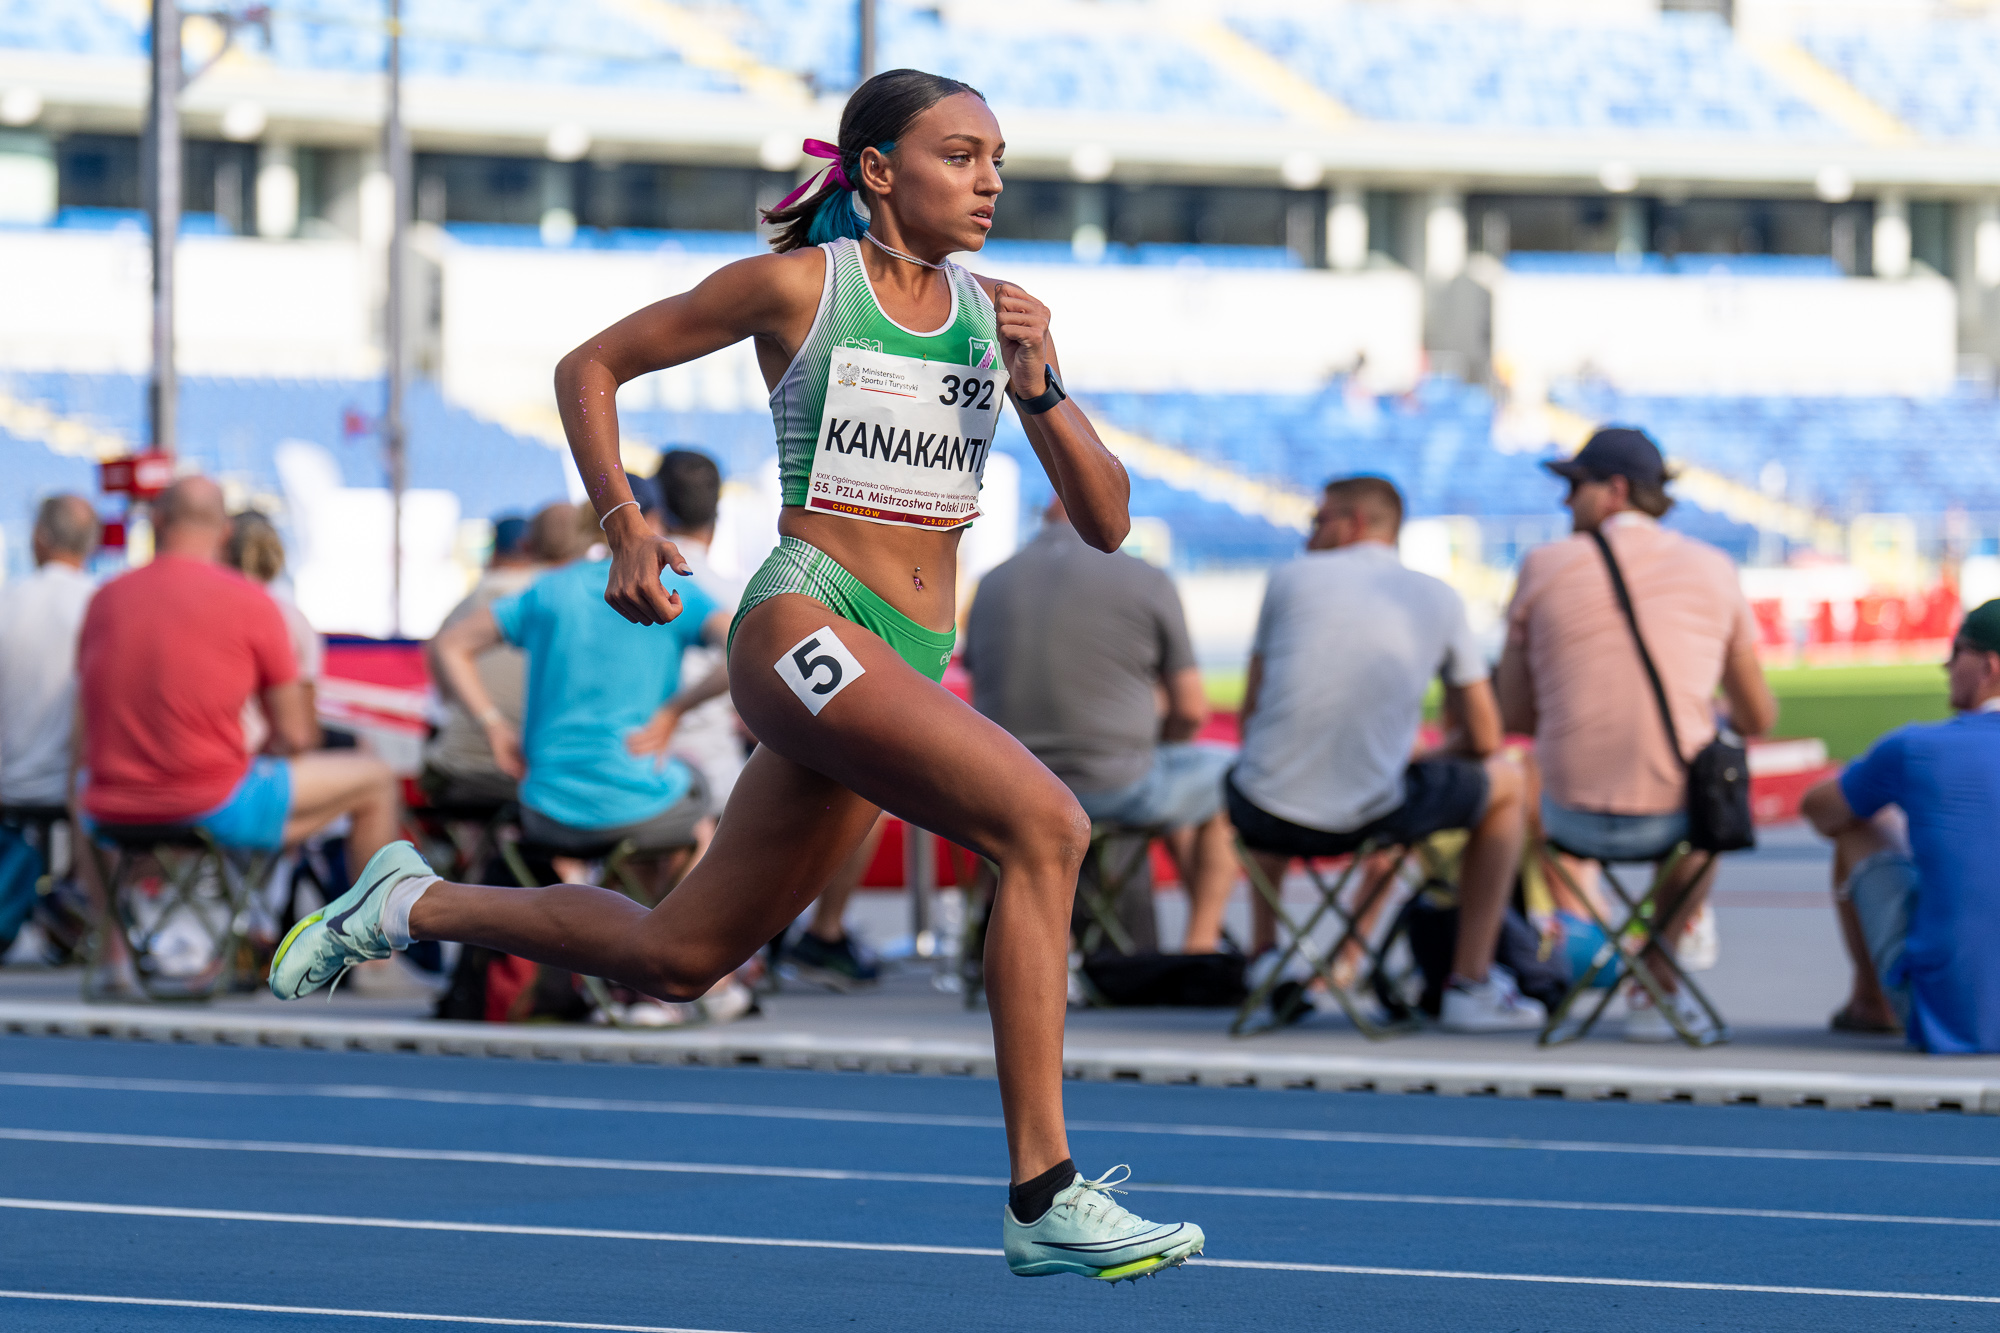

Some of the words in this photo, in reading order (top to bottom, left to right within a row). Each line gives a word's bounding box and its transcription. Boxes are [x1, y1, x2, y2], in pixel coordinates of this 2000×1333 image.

[861, 376, 884, 386] Sportu
[888, 380, 919, 392] Turystyki
[862, 367, 905, 380] Ministerstwo
[938, 374, 995, 411] 392
[825, 418, 987, 473] KANAKANTI
[813, 481, 831, 494] 55.
[835, 485, 864, 500] PZLA
[868, 491, 932, 510] Mistrzostwa
[935, 501, 960, 512] Polski
[816, 472, 831, 480] XXIX
[831, 475, 879, 489] Ogólnopolska
[880, 484, 913, 495] Olimpiada
[832, 503, 880, 517] CHORZÓW
[792, 637, 843, 695] 5
